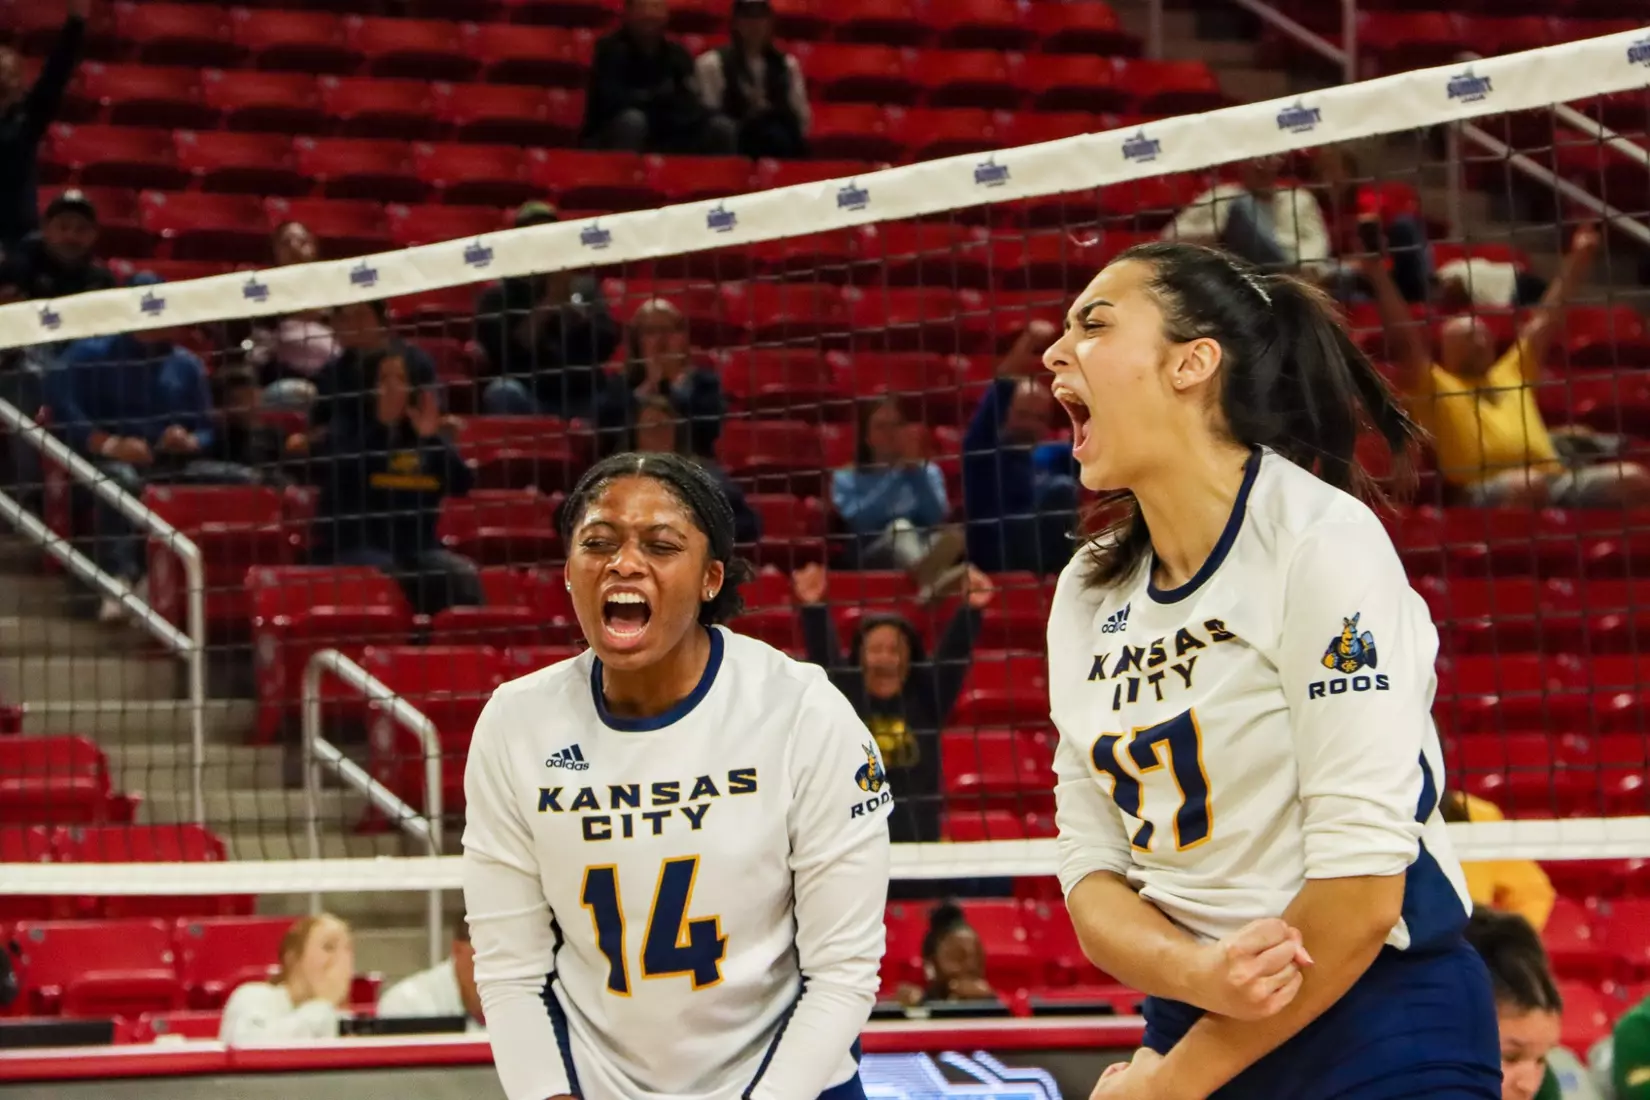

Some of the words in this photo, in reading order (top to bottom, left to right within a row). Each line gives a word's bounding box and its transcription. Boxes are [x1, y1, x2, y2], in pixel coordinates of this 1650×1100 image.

[1087, 618, 1238, 681] KANSAS
[1308, 673, 1390, 700] ROOS
[545, 757, 590, 771] adidas
[1090, 707, 1213, 853] 17
[537, 767, 759, 813] KANSAS
[581, 803, 711, 841] CITY
[580, 854, 729, 998] 14
